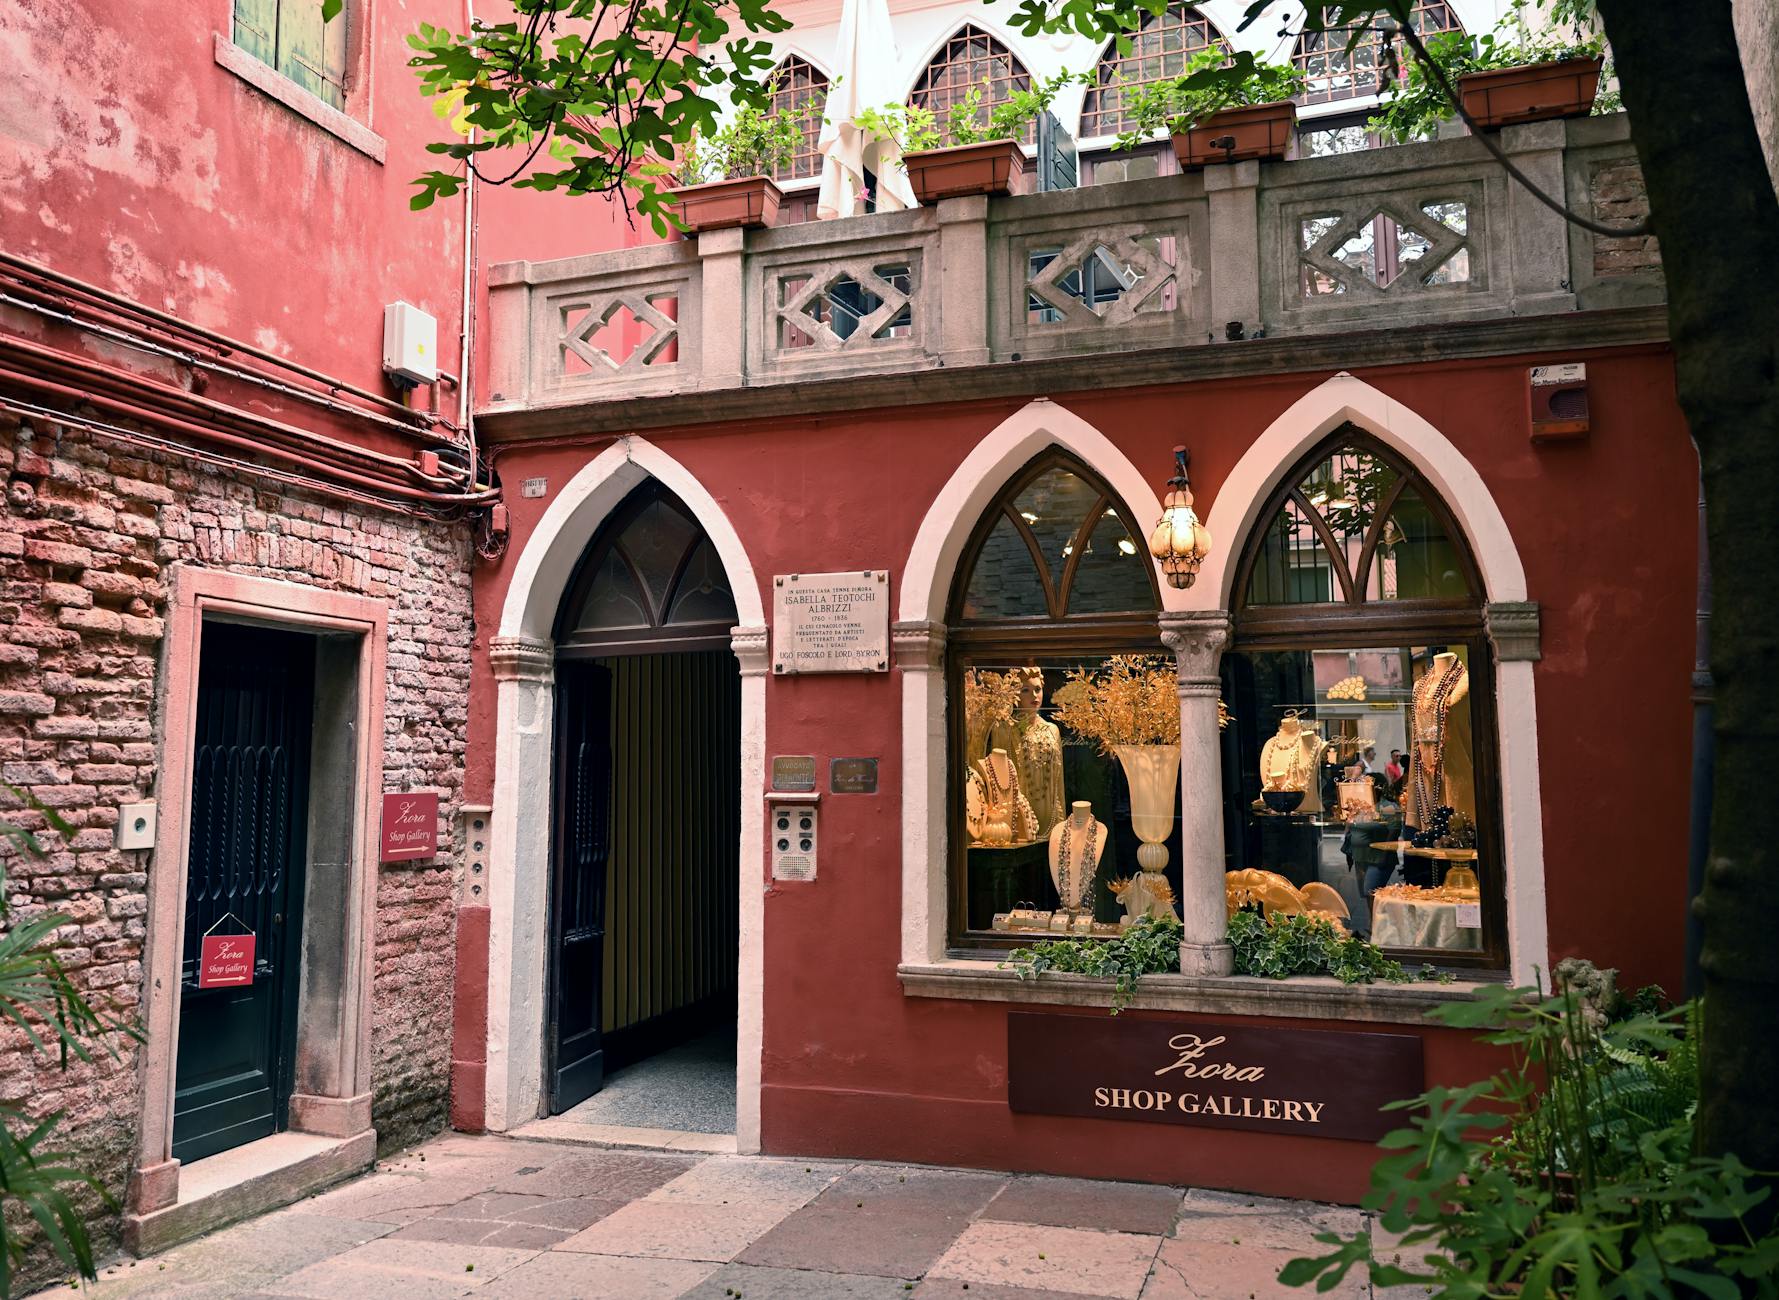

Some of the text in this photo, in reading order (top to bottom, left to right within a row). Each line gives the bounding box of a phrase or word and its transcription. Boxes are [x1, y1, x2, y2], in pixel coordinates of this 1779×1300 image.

[785, 593, 875, 605] ISABELLA TEOTOCHI
[808, 604, 851, 613] ALBRIZZI
[797, 651, 825, 659] FOSCOLO
[835, 650, 852, 658] LORD
[856, 649, 880, 657] BYRON
[394, 801, 427, 824] Zora
[389, 829, 431, 844] Shop Gallery
[214, 941, 244, 960] Zora
[208, 963, 248, 975] Shop Gallery
[1154, 1033, 1265, 1083] Zora
[1094, 1087, 1325, 1123] SHOP GALLERY
